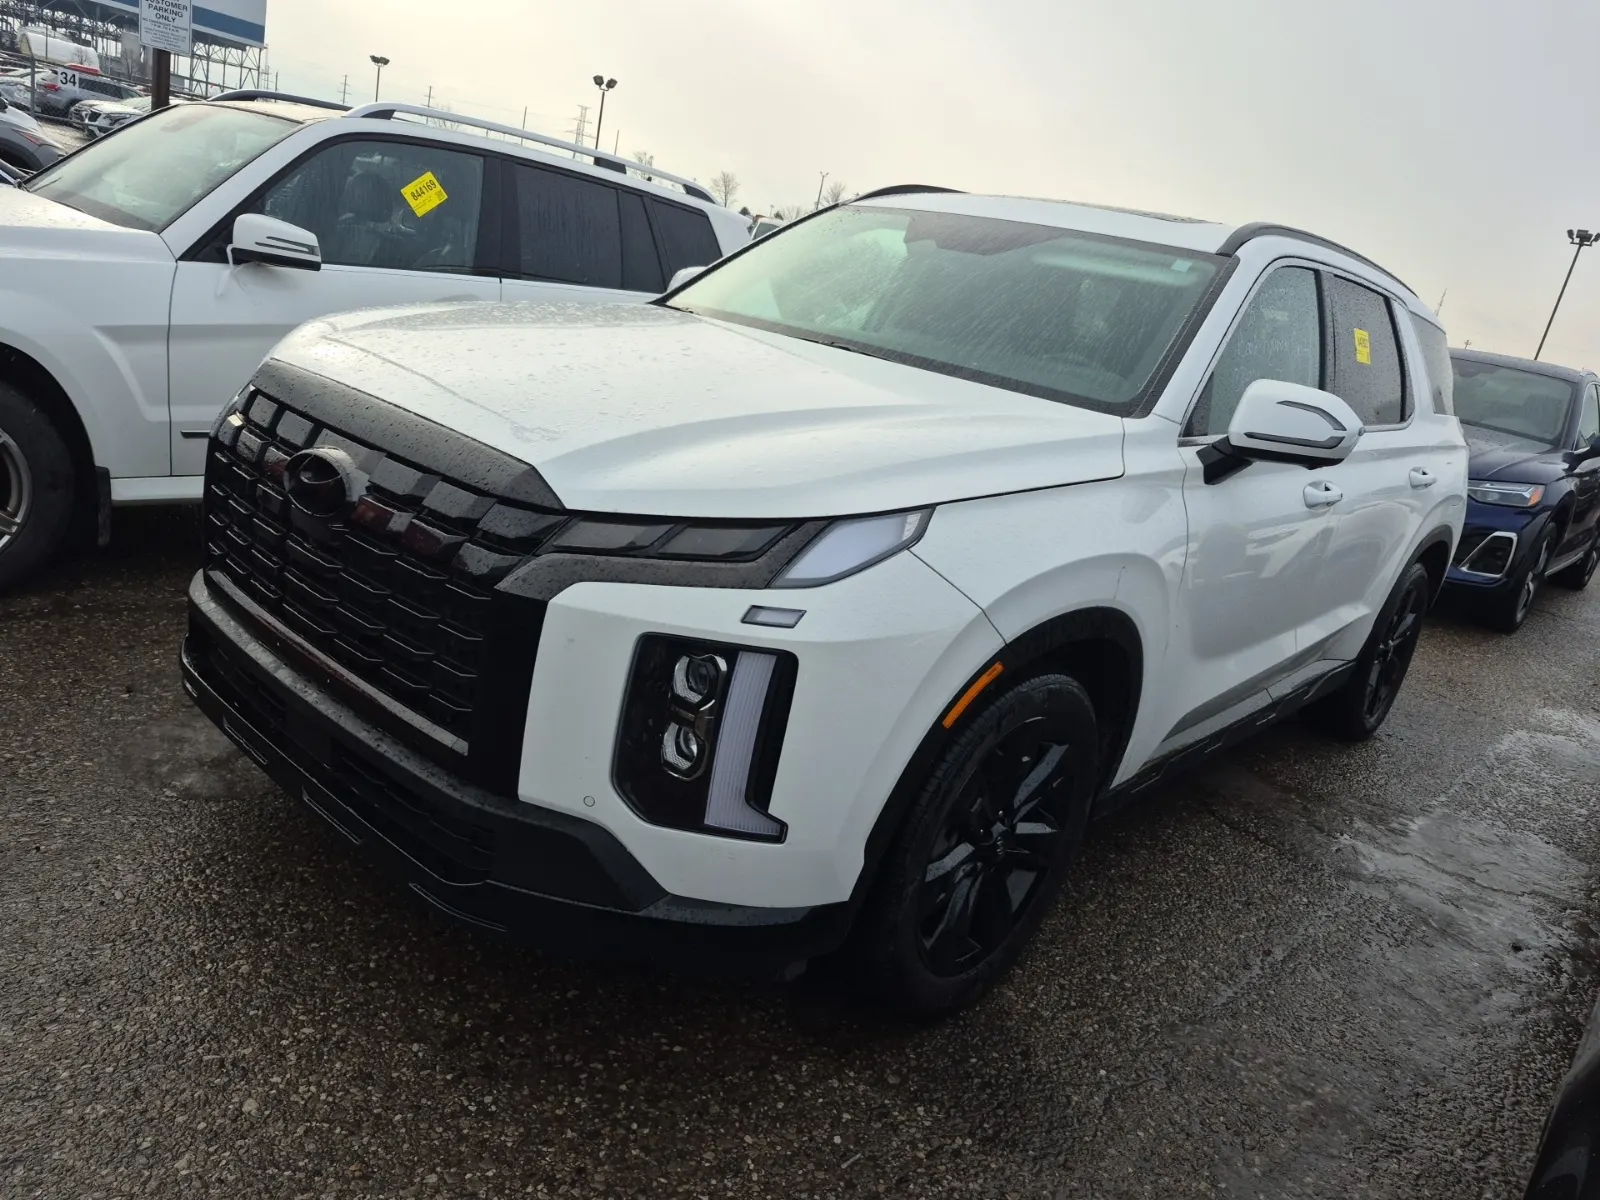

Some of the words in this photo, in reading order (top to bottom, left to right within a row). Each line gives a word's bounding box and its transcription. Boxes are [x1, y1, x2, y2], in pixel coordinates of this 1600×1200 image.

[148, 3, 183, 18] PARKING
[155, 12, 176, 24] ONLY
[60, 71, 77, 87] 34
[410, 179, 437, 201] 844169
